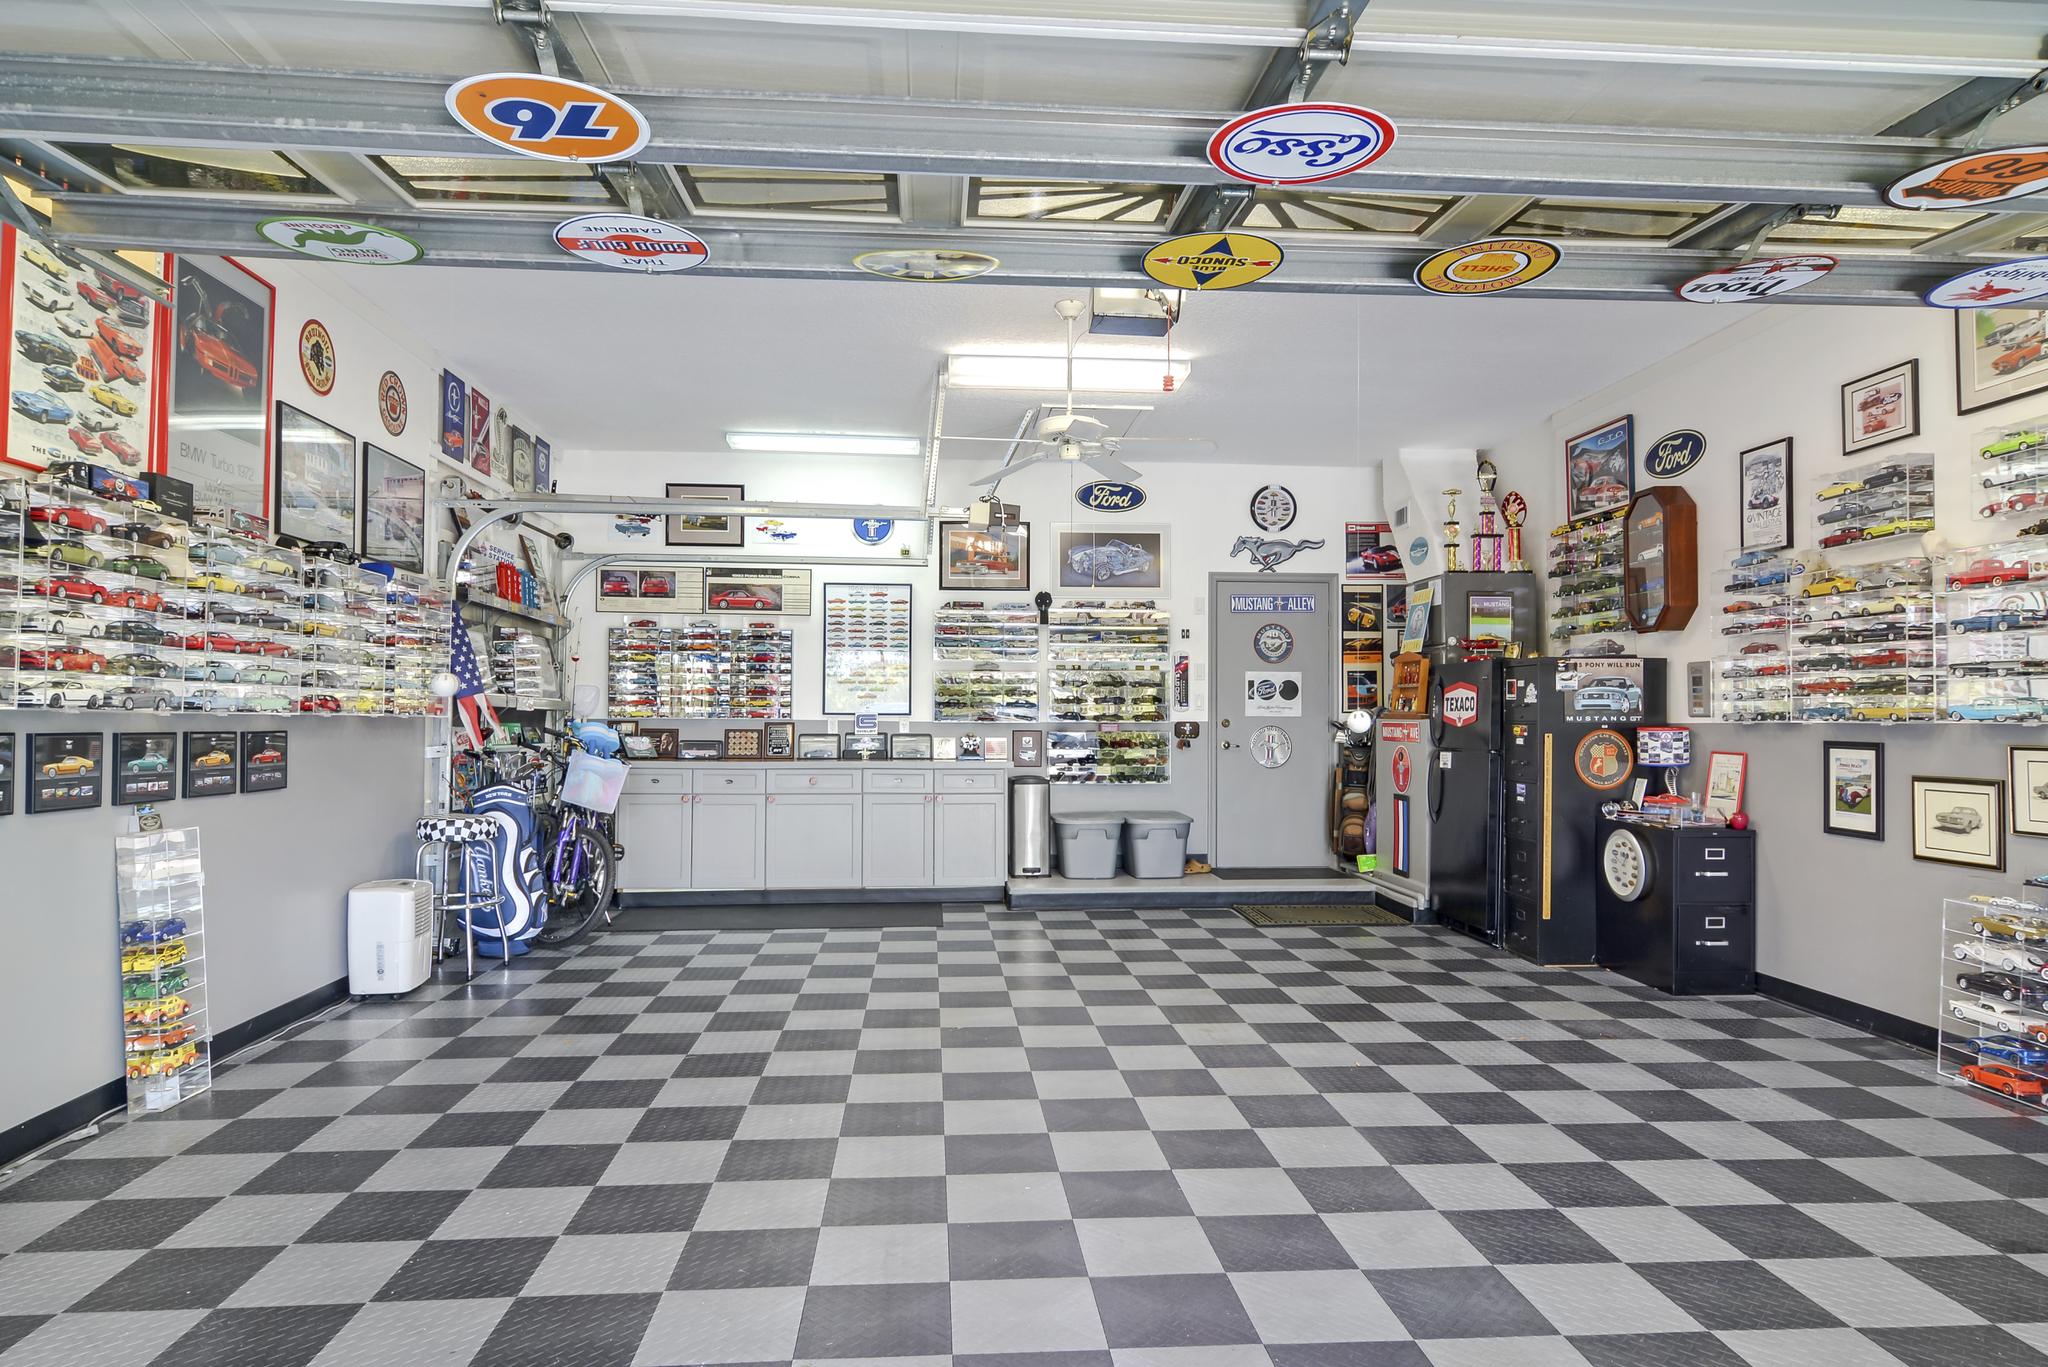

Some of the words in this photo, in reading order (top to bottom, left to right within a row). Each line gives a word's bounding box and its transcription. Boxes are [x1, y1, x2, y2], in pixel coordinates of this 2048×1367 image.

[486, 99, 617, 140] 76
[1234, 129, 1371, 167] Esso
[1923, 180, 2012, 197] Phillips
[280, 222, 352, 230] GASOLINE
[583, 226, 662, 234] GASOLINE
[578, 239, 631, 251] GULF
[634, 240, 691, 253] GOOD
[1453, 241, 1553, 259] GASOLINE
[622, 257, 667, 266] THAT
[1177, 255, 1249, 267] SUNOCO
[1461, 264, 1513, 273] SHELL
[1979, 267, 2048, 281] obilgas
[1428, 274, 1449, 288] OIL
[1450, 276, 1522, 291] MOTOR
[1687, 278, 1788, 297] TYDOL
[31, 445, 46, 455] THE
[1654, 438, 1692, 473] Ford
[180, 442, 207, 464] BMW
[210, 452, 234, 473] Turbo
[1090, 485, 1132, 507] Ford
[488, 545, 515, 560] SERVICE
[1235, 597, 1274, 611] MUSTANG
[1287, 597, 1313, 611] ALLEY
[1256, 625, 1290, 639] MUSTANG
[1444, 696, 1475, 712] TEXACO
